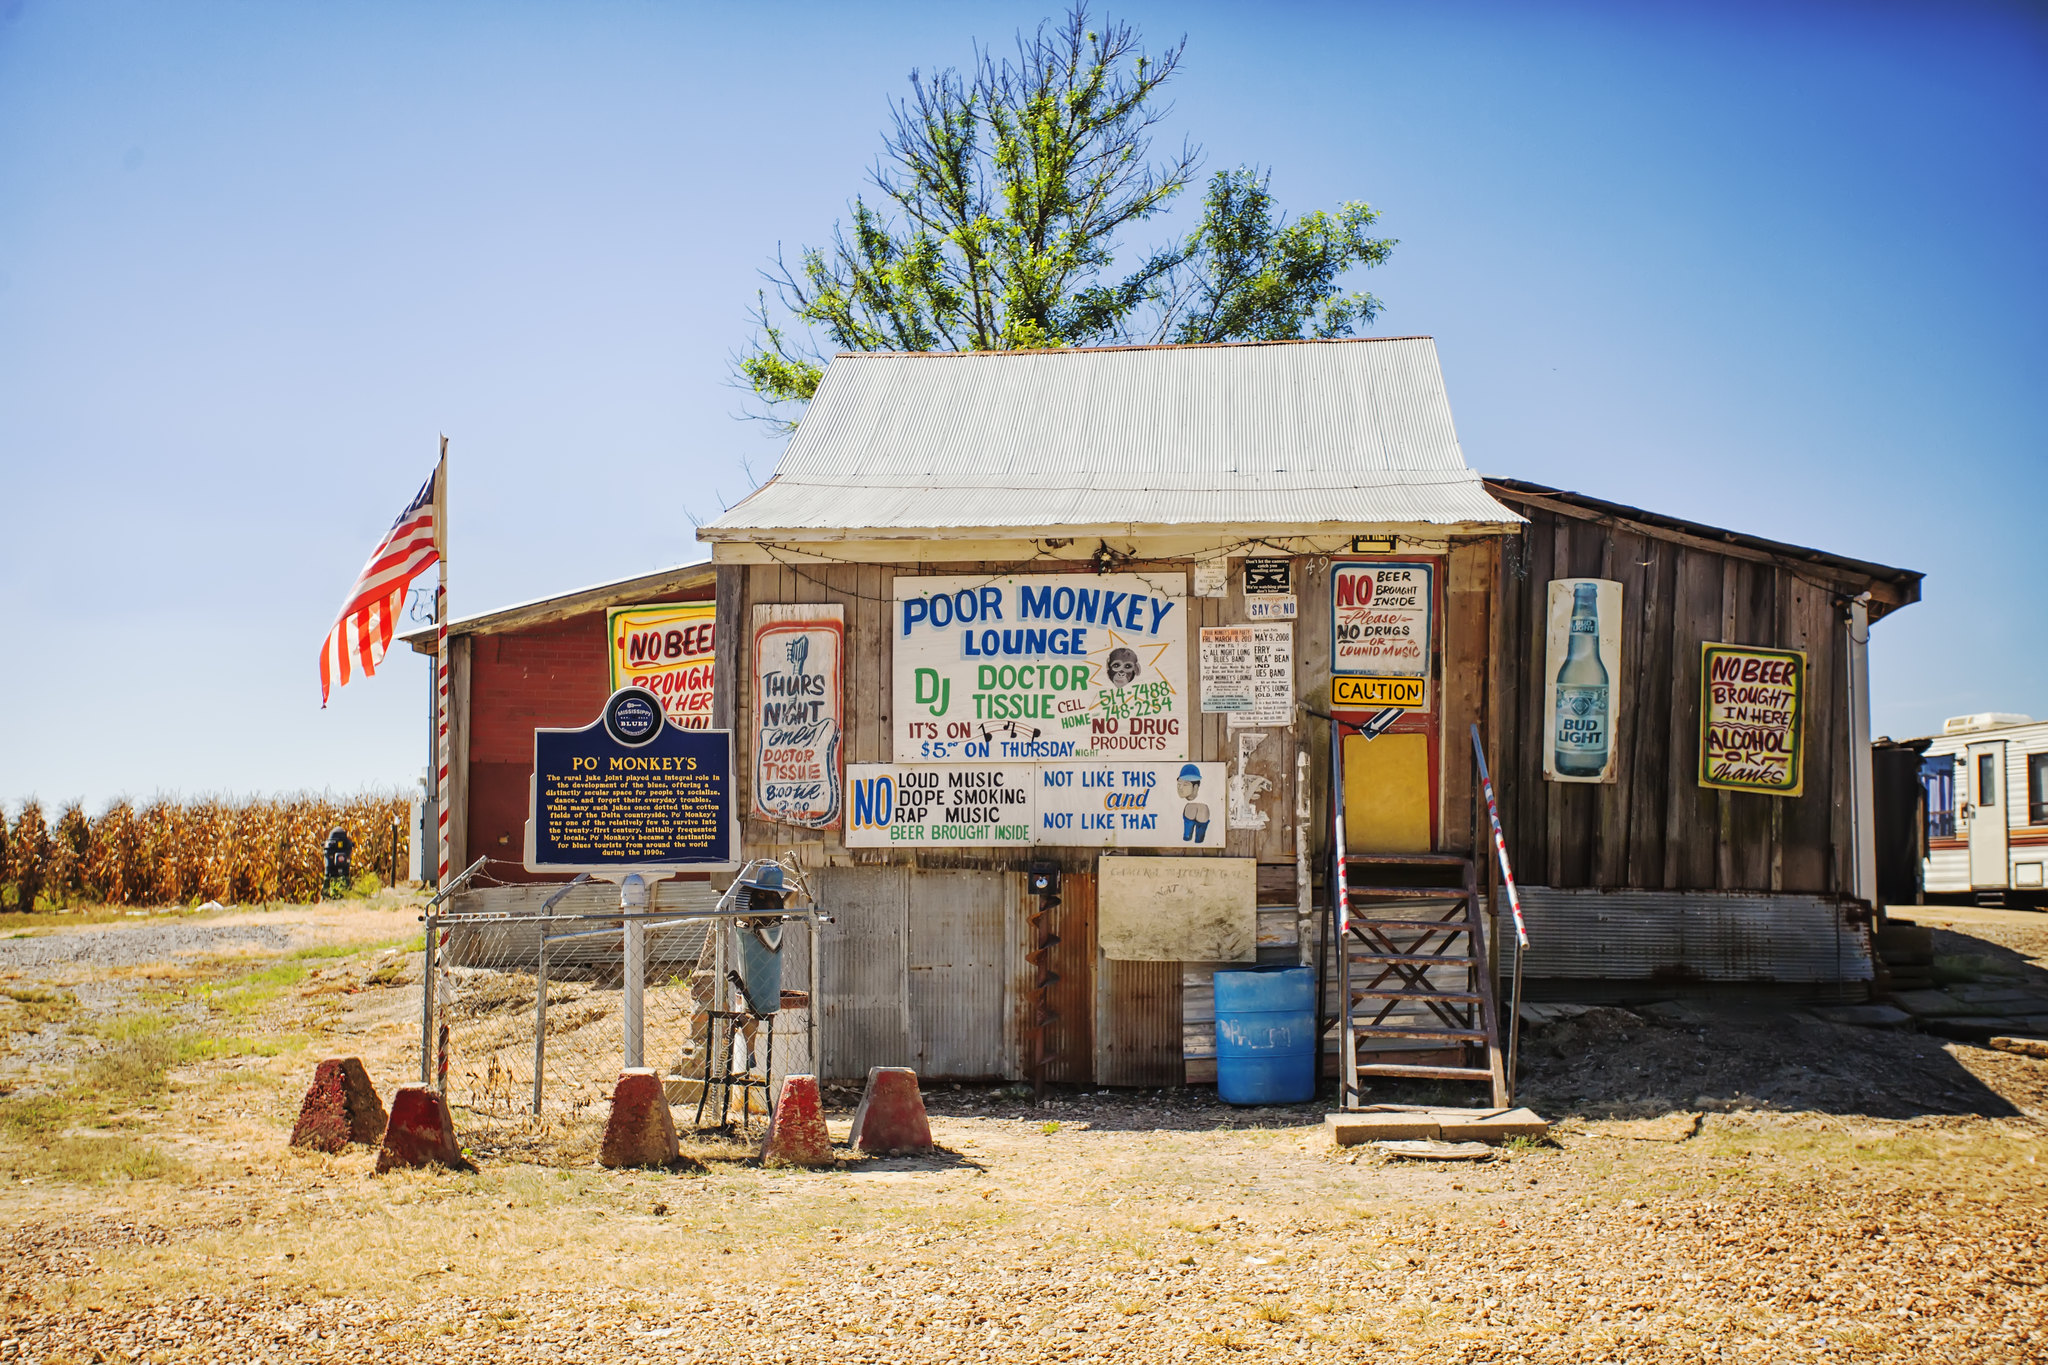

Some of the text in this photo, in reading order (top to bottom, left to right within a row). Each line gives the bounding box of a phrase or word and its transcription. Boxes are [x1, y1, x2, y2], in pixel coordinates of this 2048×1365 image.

[1336, 571, 1411, 606] NO BEER
[1376, 586, 1418, 596] BROUGHT
[1252, 602, 1294, 616] SAY NO
[1372, 596, 1416, 606] INSIDE
[902, 585, 1175, 637] POOR MONKEY
[1344, 609, 1402, 625] Please
[1337, 624, 1410, 640] NO DRUGS
[630, 624, 716, 660] NO BEE
[963, 629, 1088, 657] LOUNGE
[1369, 638, 1386, 646] OR
[1382, 645, 1421, 658] MUSIC
[1711, 656, 1797, 687] NO BEER
[763, 670, 826, 698] THURS
[914, 664, 1090, 716] DJ DOCTOR
[1338, 682, 1420, 700] CAUTION
[1057, 681, 1170, 713] CELL 514-7488
[1712, 687, 1796, 710] BROUGHT
[764, 700, 825, 728] NIGHT
[972, 694, 1056, 720] TISSUE
[1102, 696, 1172, 722] 748-2254
[1723, 706, 1748, 720] IN
[909, 722, 971, 739] IT'S ON
[1092, 717, 1180, 736] NO DRUG
[1564, 719, 1598, 731] BUD
[1090, 736, 1166, 750] PRODUCTS
[1558, 730, 1602, 744] LIGHT
[1707, 729, 1793, 753] ALCOHOL
[764, 748, 814, 762] DOCTOR
[964, 742, 990, 758] ON
[1001, 742, 1075, 758] THURSDAY
[1075, 748, 1100, 758] NIGHT
[572, 756, 698, 770] PO' MONKEY'S
[762, 762, 821, 780] TISSUE
[585, 774, 601, 782] juke
[605, 774, 622, 782] joint
[626, 774, 649, 782] played
[664, 774, 692, 782] integral
[1044, 771, 1157, 788] NOT LIKE THIS
[1711, 763, 1785, 784] Thanks
[546, 789, 580, 797] distinctly
[650, 789, 672, 797] people
[573, 781, 616, 790] development
[672, 781, 700, 790] offering
[598, 796, 619, 805] forget
[644, 796, 676, 805] everyday
[852, 772, 1005, 829] NO LOUD MUSIC
[899, 788, 1026, 806] DOPE SMOKING
[1104, 788, 1149, 811] and
[612, 804, 631, 812] jukes
[685, 811, 716, 819] Monkey's
[894, 806, 1000, 824] RAP MUSIC
[609, 819, 643, 827] relatively
[1044, 812, 1158, 830] NOT LIKE THAT
[550, 834, 560, 842] by
[603, 834, 635, 842] Monkey's
[565, 826, 609, 834] twenty-first
[645, 826, 673, 834] Initially
[677, 826, 717, 834] frequented
[890, 824, 1030, 840] BEER BROUGHT INSIDE
[602, 848, 664, 857] during the 1990s.
